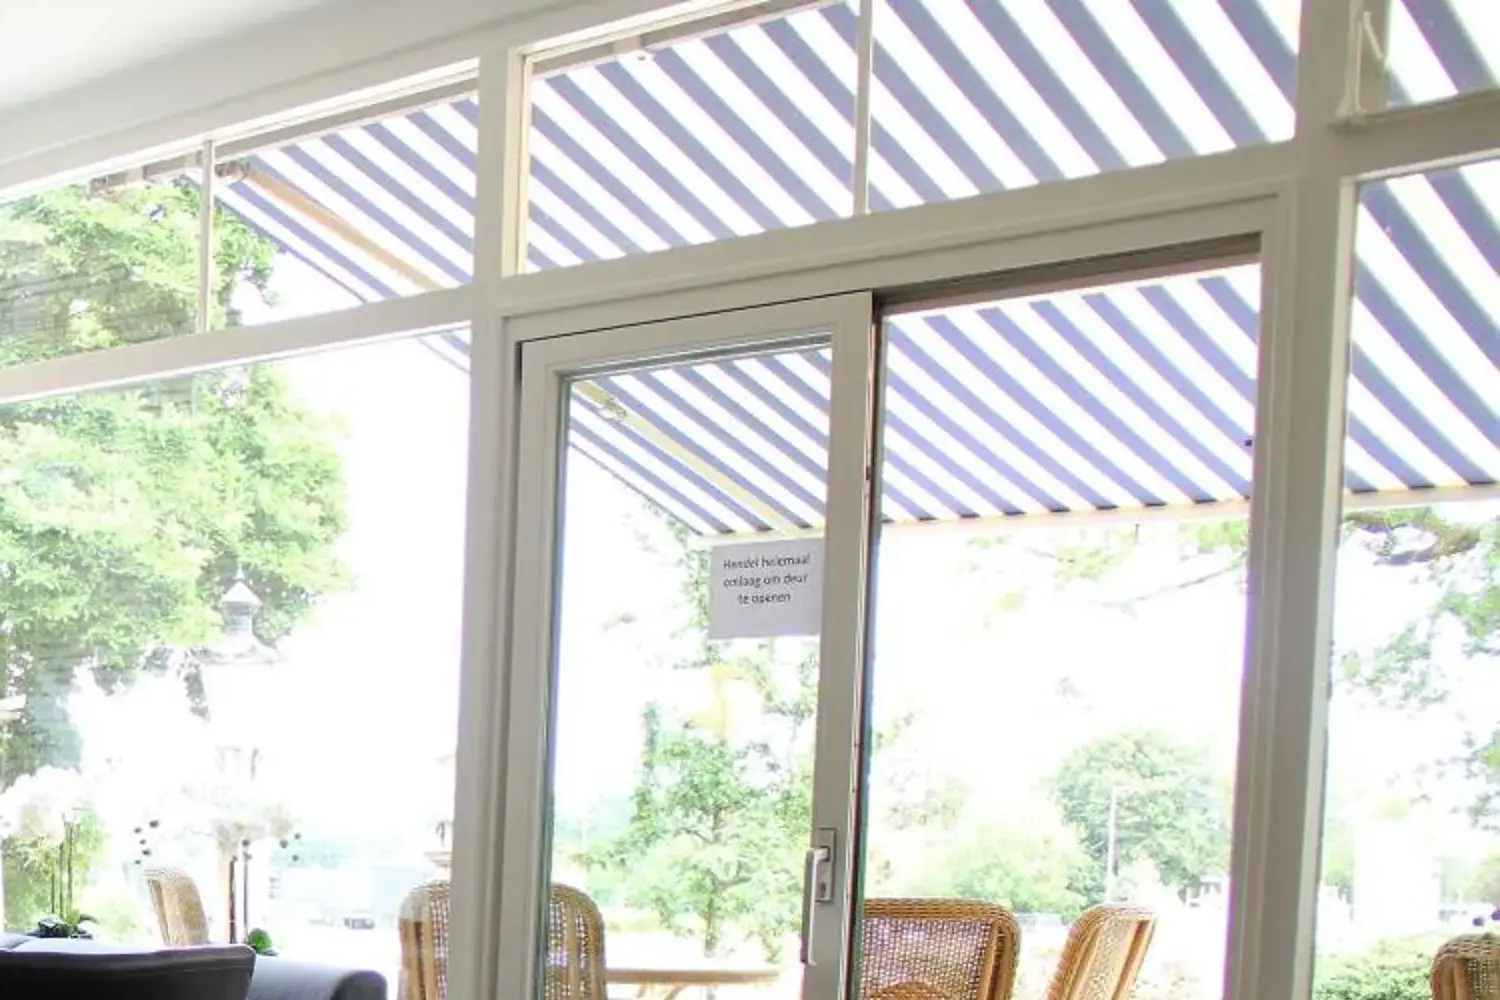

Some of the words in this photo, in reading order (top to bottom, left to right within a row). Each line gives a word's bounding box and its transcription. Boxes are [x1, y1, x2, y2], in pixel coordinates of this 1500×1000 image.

[763, 575, 780, 585] om
[784, 573, 808, 584] deur
[739, 594, 750, 604] te
[751, 593, 791, 604] openen
